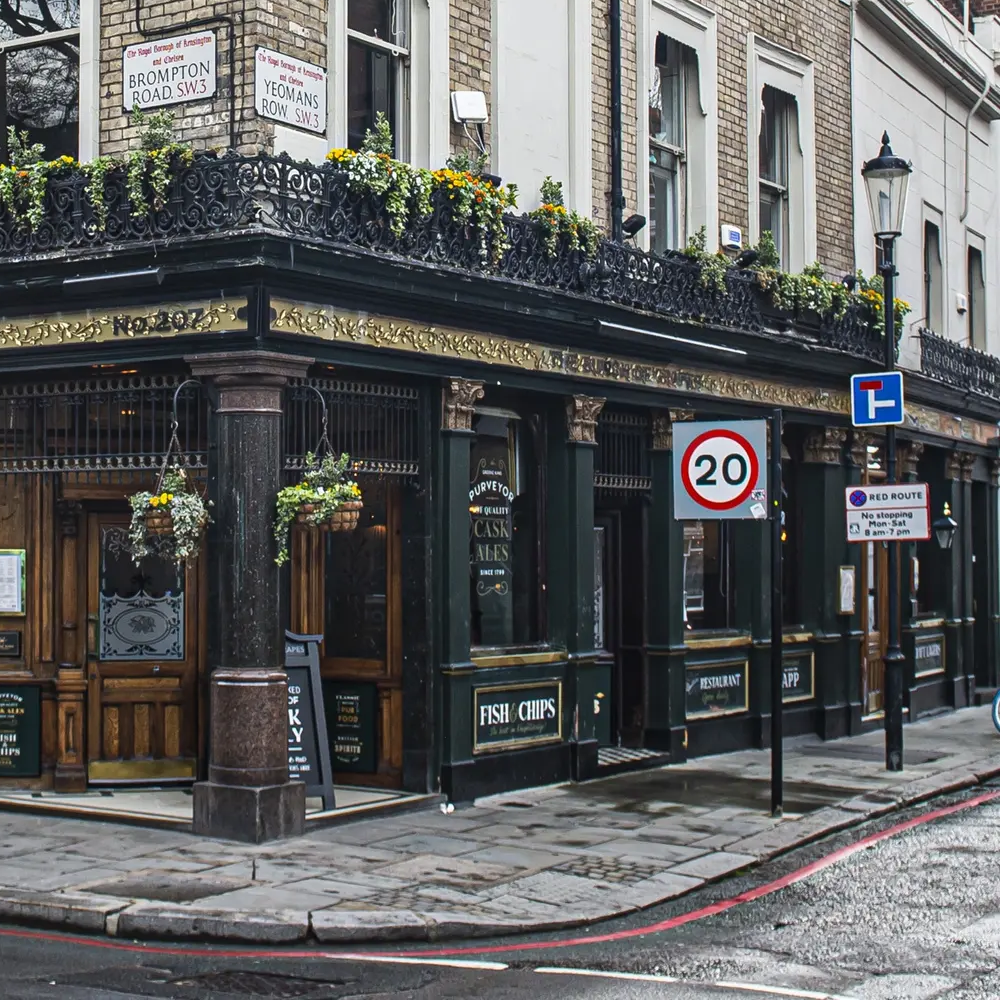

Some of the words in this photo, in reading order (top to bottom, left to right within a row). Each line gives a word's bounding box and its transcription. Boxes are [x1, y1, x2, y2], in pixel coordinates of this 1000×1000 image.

[126, 50, 136, 58] The
[153, 42, 174, 53] Borough
[175, 40, 182, 49] of
[183, 36, 212, 47] Kensington
[152, 58, 161, 66] and
[163, 54, 184, 64] Chelsea
[129, 60, 210, 89] BROMPTON
[177, 78, 207, 97] S.W.3
[264, 78, 319, 109] YEOMANS
[694, 453, 748, 486] 20
[469, 480, 514, 503] PURVEYOR
[869, 493, 888, 501] RED
[891, 492, 923, 500] ROUTE
[483, 506, 509, 516] QUALITY
[861, 512, 874, 520] No
[876, 511, 913, 520] stopping
[474, 520, 509, 538] CASK
[896, 529, 910, 537] pm
[475, 543, 509, 561] ALES
[480, 568, 493, 576] SINCE
[700, 673, 741, 690] RESTAURANT
[479, 702, 509, 726] FISH
[509, 702, 518, 723] &
[518, 697, 556, 721] CHIPS
